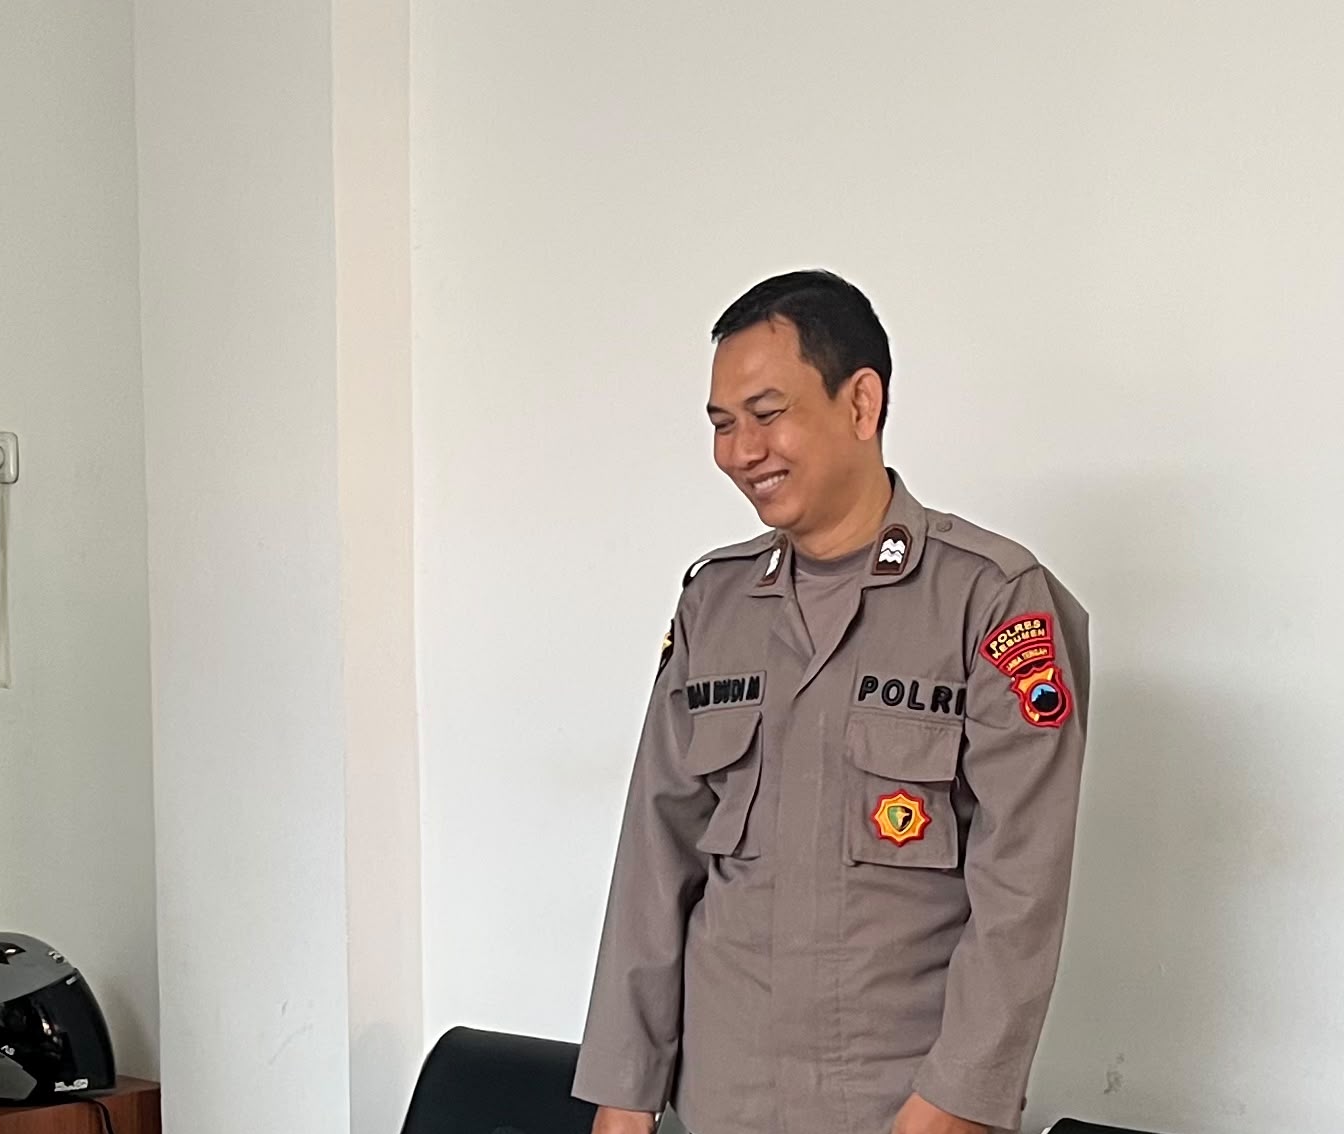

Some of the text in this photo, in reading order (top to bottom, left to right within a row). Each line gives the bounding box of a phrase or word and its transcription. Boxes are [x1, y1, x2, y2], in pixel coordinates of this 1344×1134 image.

[989, 619, 1041, 651] POLRES
[992, 628, 1046, 659] KEBUMEN
[858, 675, 967, 716] POLRI
